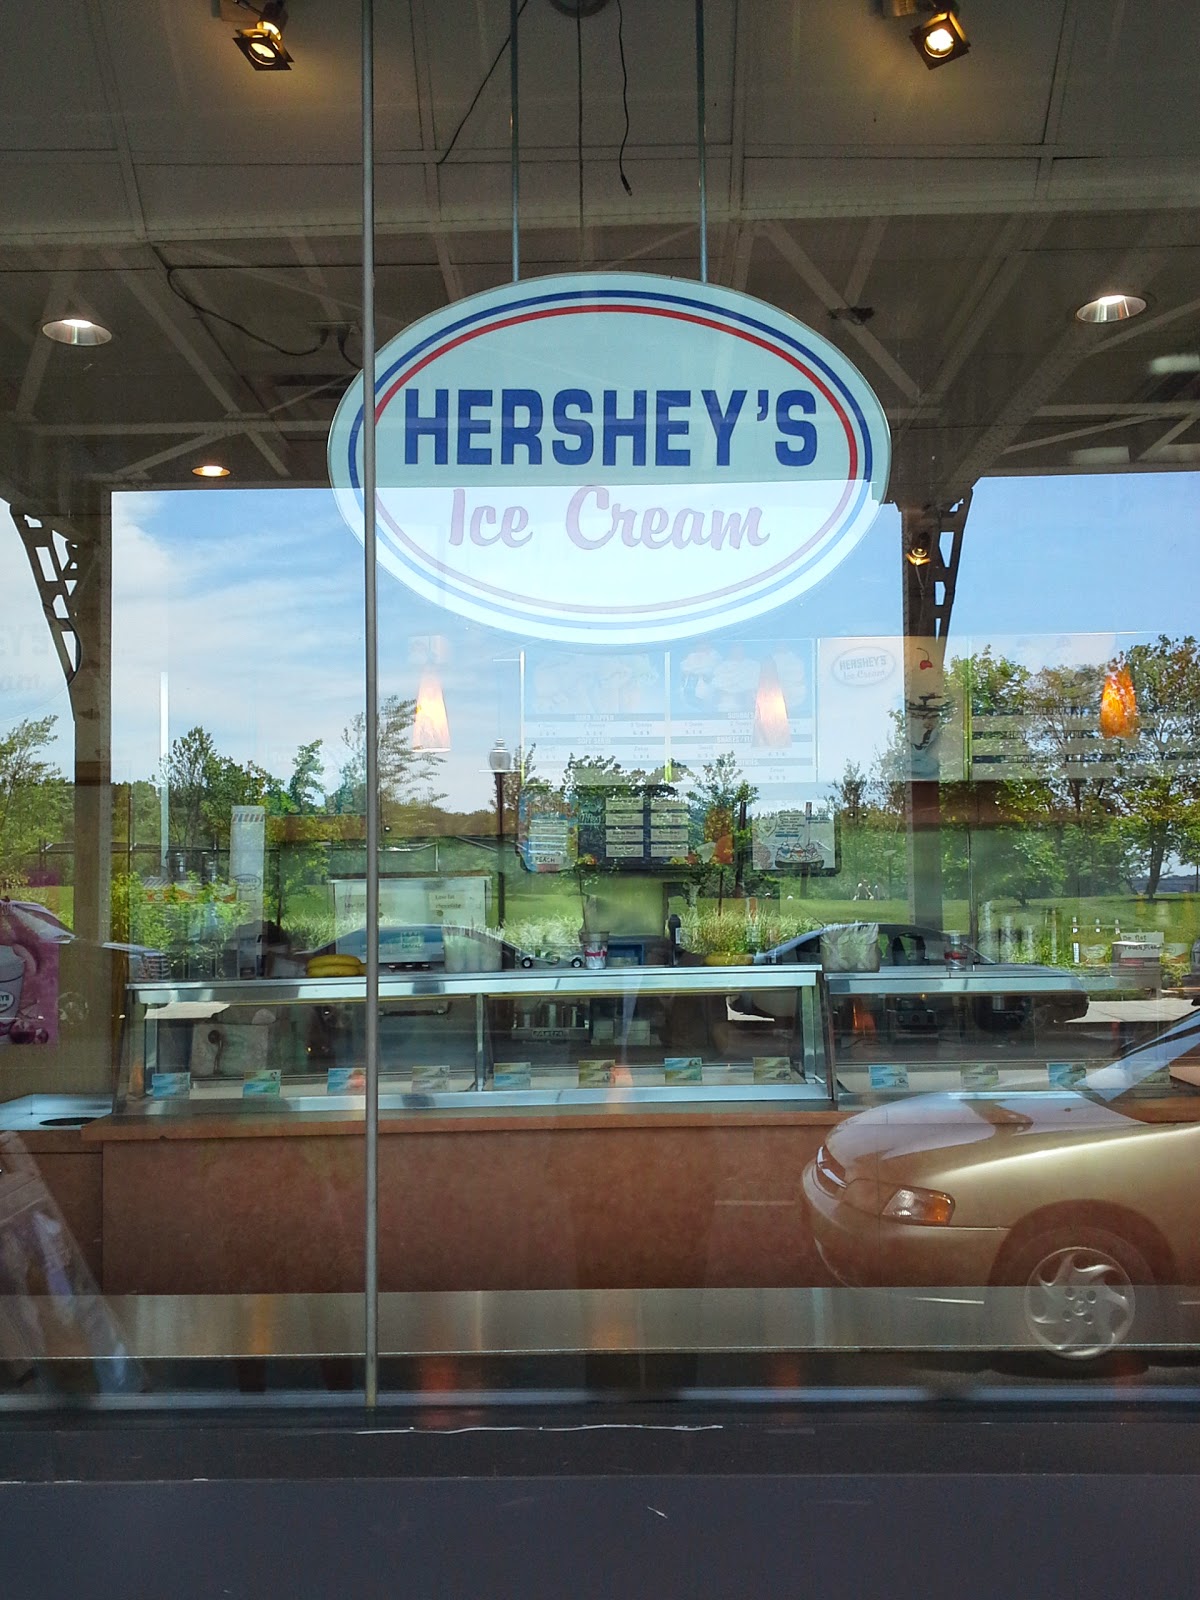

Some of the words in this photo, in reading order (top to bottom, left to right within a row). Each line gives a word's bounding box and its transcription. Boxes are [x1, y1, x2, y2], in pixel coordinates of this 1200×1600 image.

[404, 388, 818, 467] HERSHEY'S
[448, 488, 534, 549] Ice
[565, 485, 770, 551] Cream
[839, 655, 887, 671] HERSHEY'S
